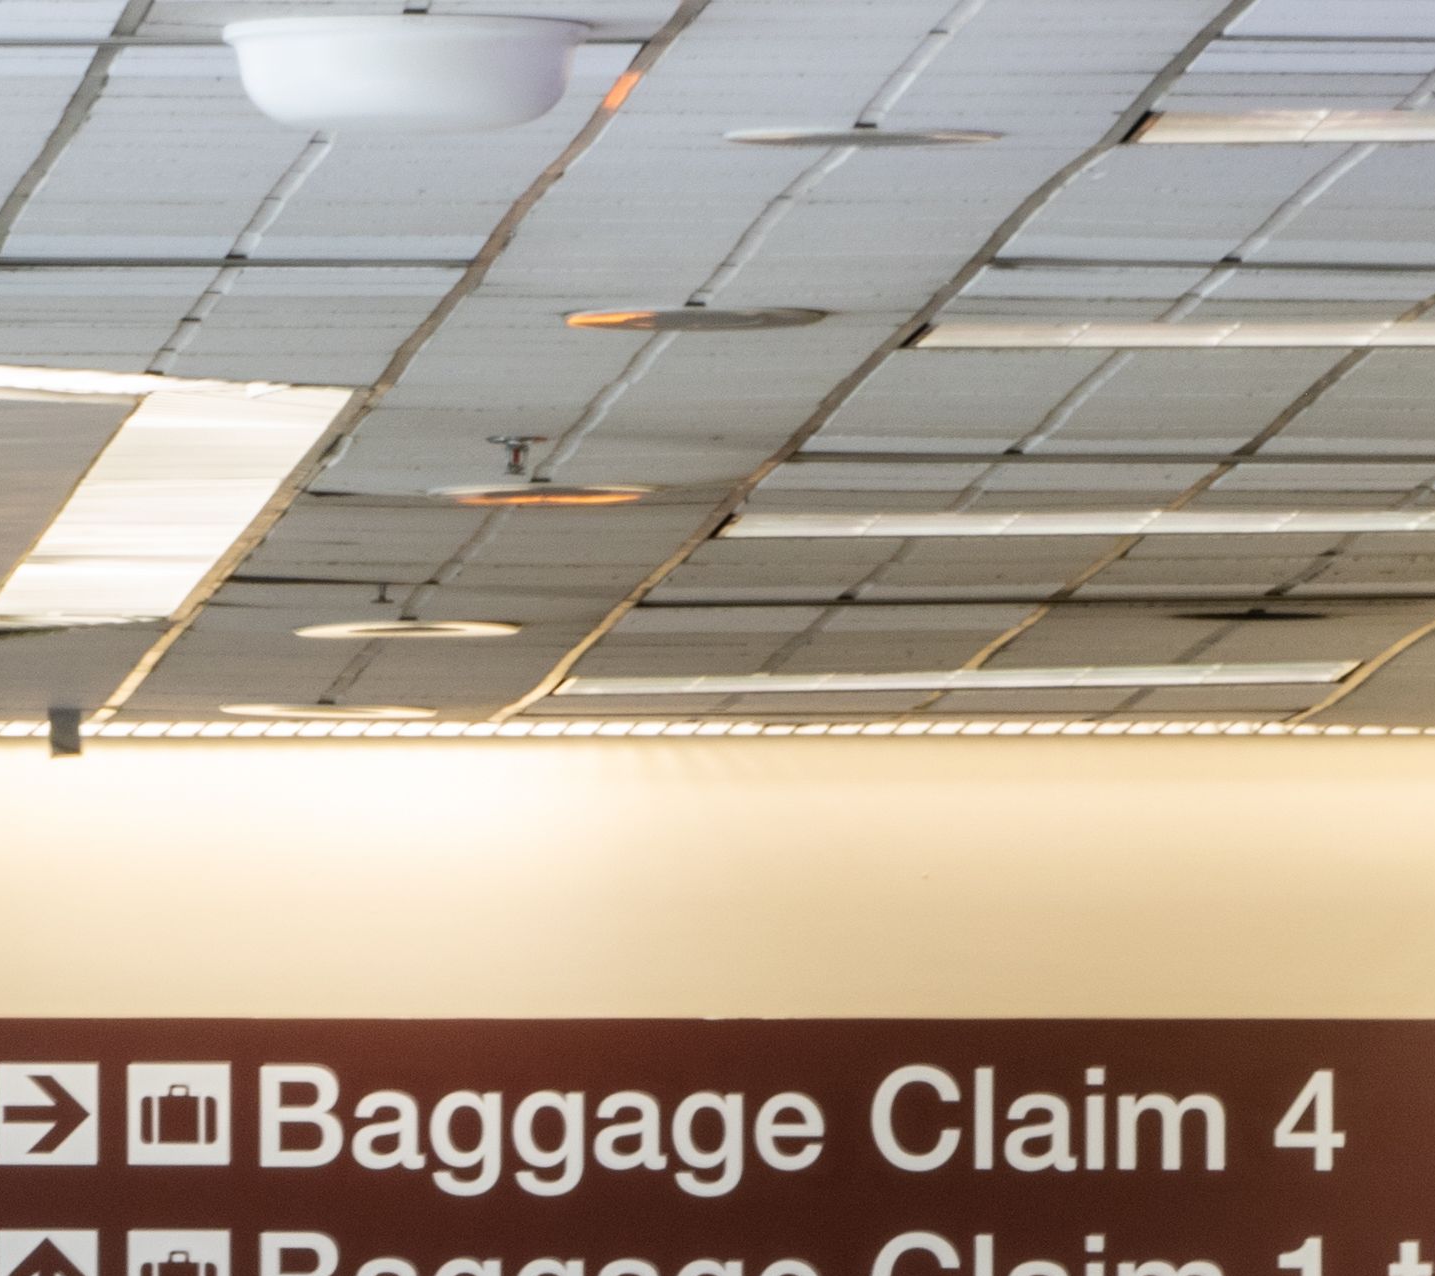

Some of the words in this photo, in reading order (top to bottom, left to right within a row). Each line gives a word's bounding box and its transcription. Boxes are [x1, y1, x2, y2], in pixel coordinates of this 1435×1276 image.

[258, 1064, 826, 1198] Baggage
[870, 1064, 1227, 1173] Claim
[1274, 1070, 1347, 1172] 4
